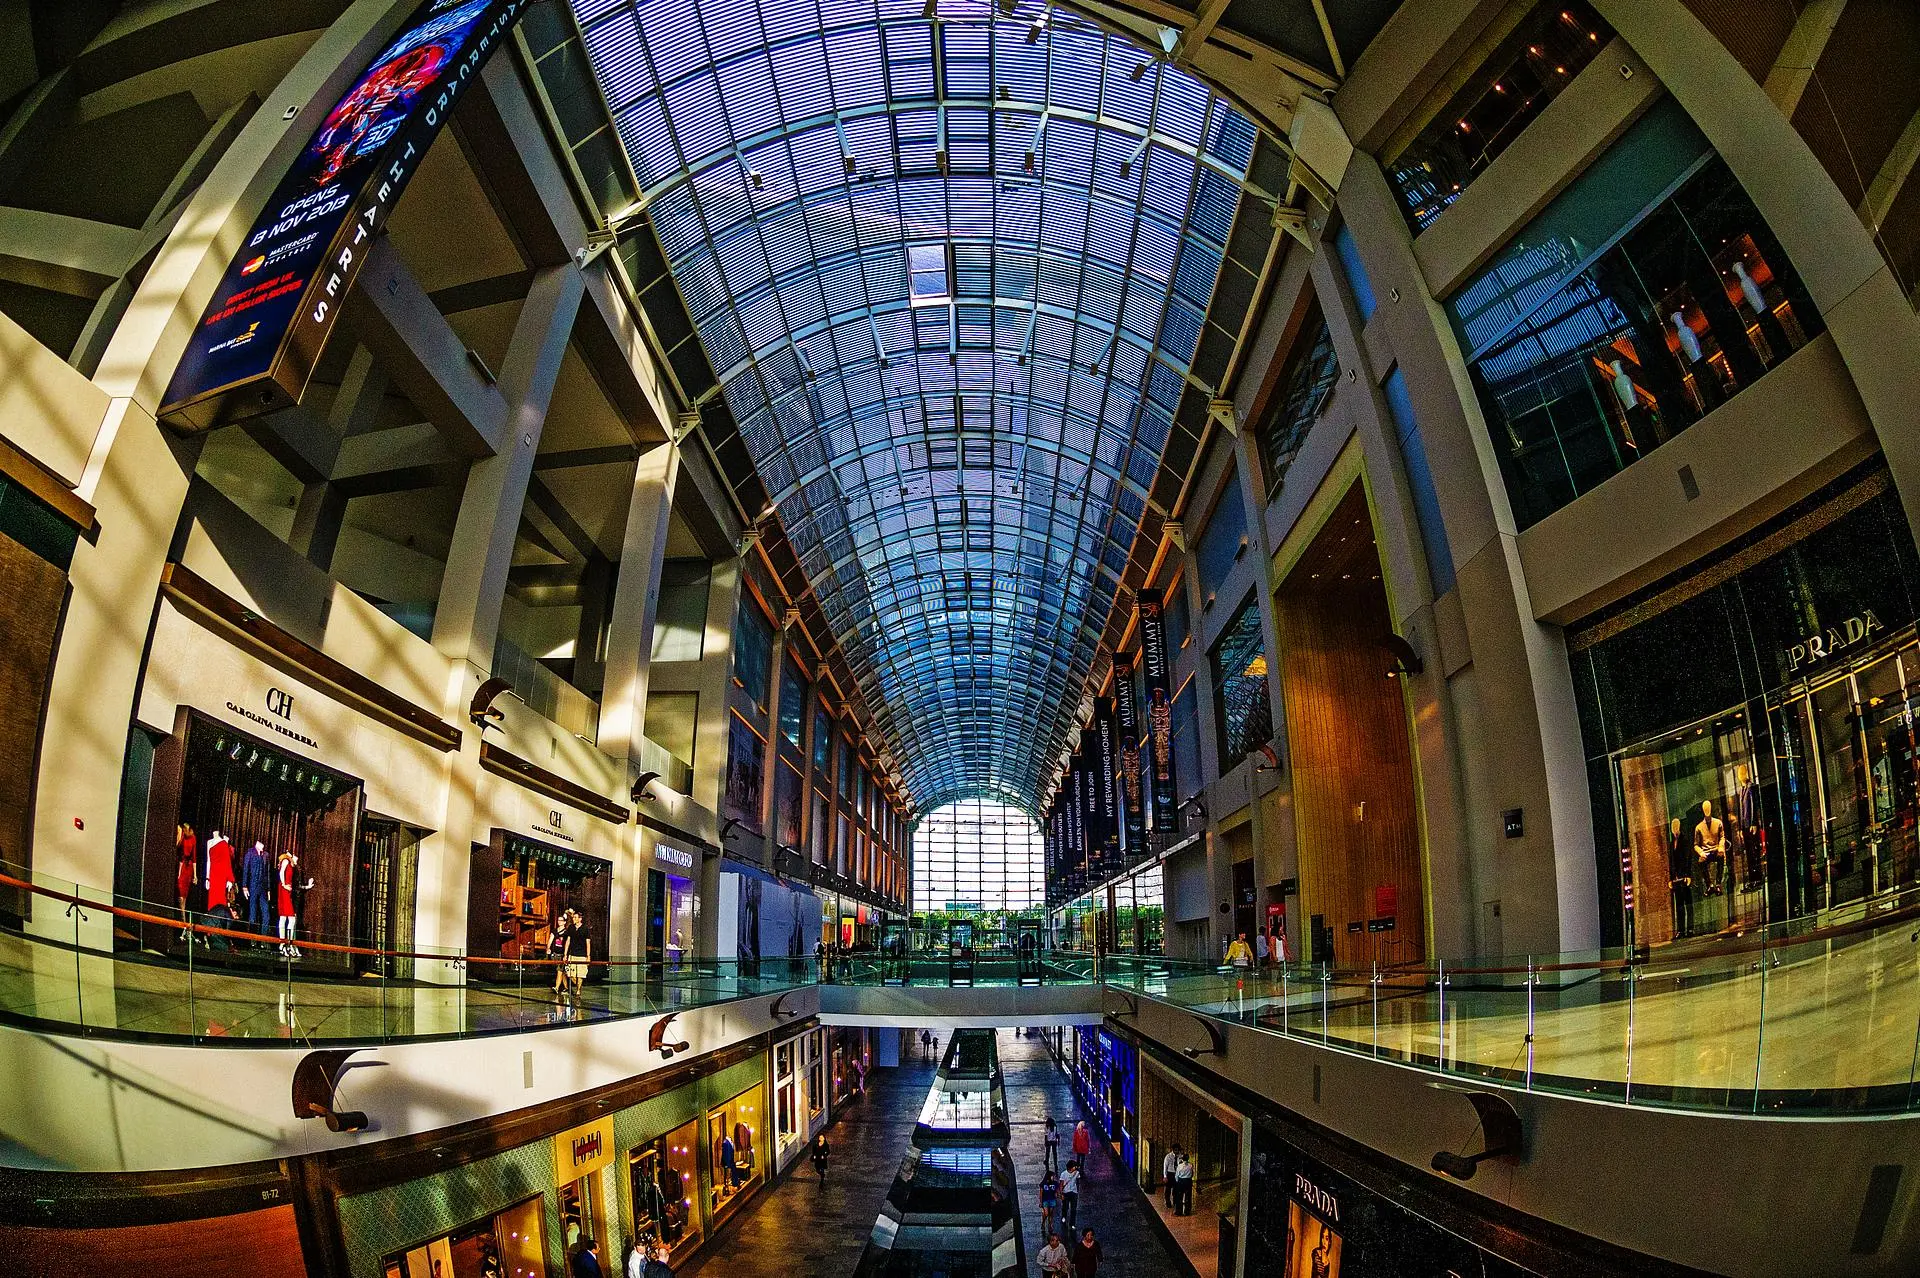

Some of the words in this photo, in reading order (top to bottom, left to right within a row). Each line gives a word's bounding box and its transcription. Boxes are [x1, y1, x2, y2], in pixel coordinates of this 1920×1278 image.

[362, 125, 394, 147] 3D
[268, 211, 308, 239] NOV
[305, 194, 351, 222] 2013
[280, 183, 341, 219] OPENS
[313, 141, 415, 323] THEATRES
[1145, 620, 1160, 677] MUMMY
[1785, 609, 1885, 672] PRADA
[226, 701, 274, 730] CAROLINA
[274, 724, 319, 749] HERRERA
[266, 687, 295, 721] CH
[1118, 678, 1131, 727] MUMMY
[1100, 719, 1110, 755] MOMENT
[1103, 755, 1113, 804] REWARDING
[549, 810, 562, 828] CH
[1295, 1173, 1339, 1221] PRADA
